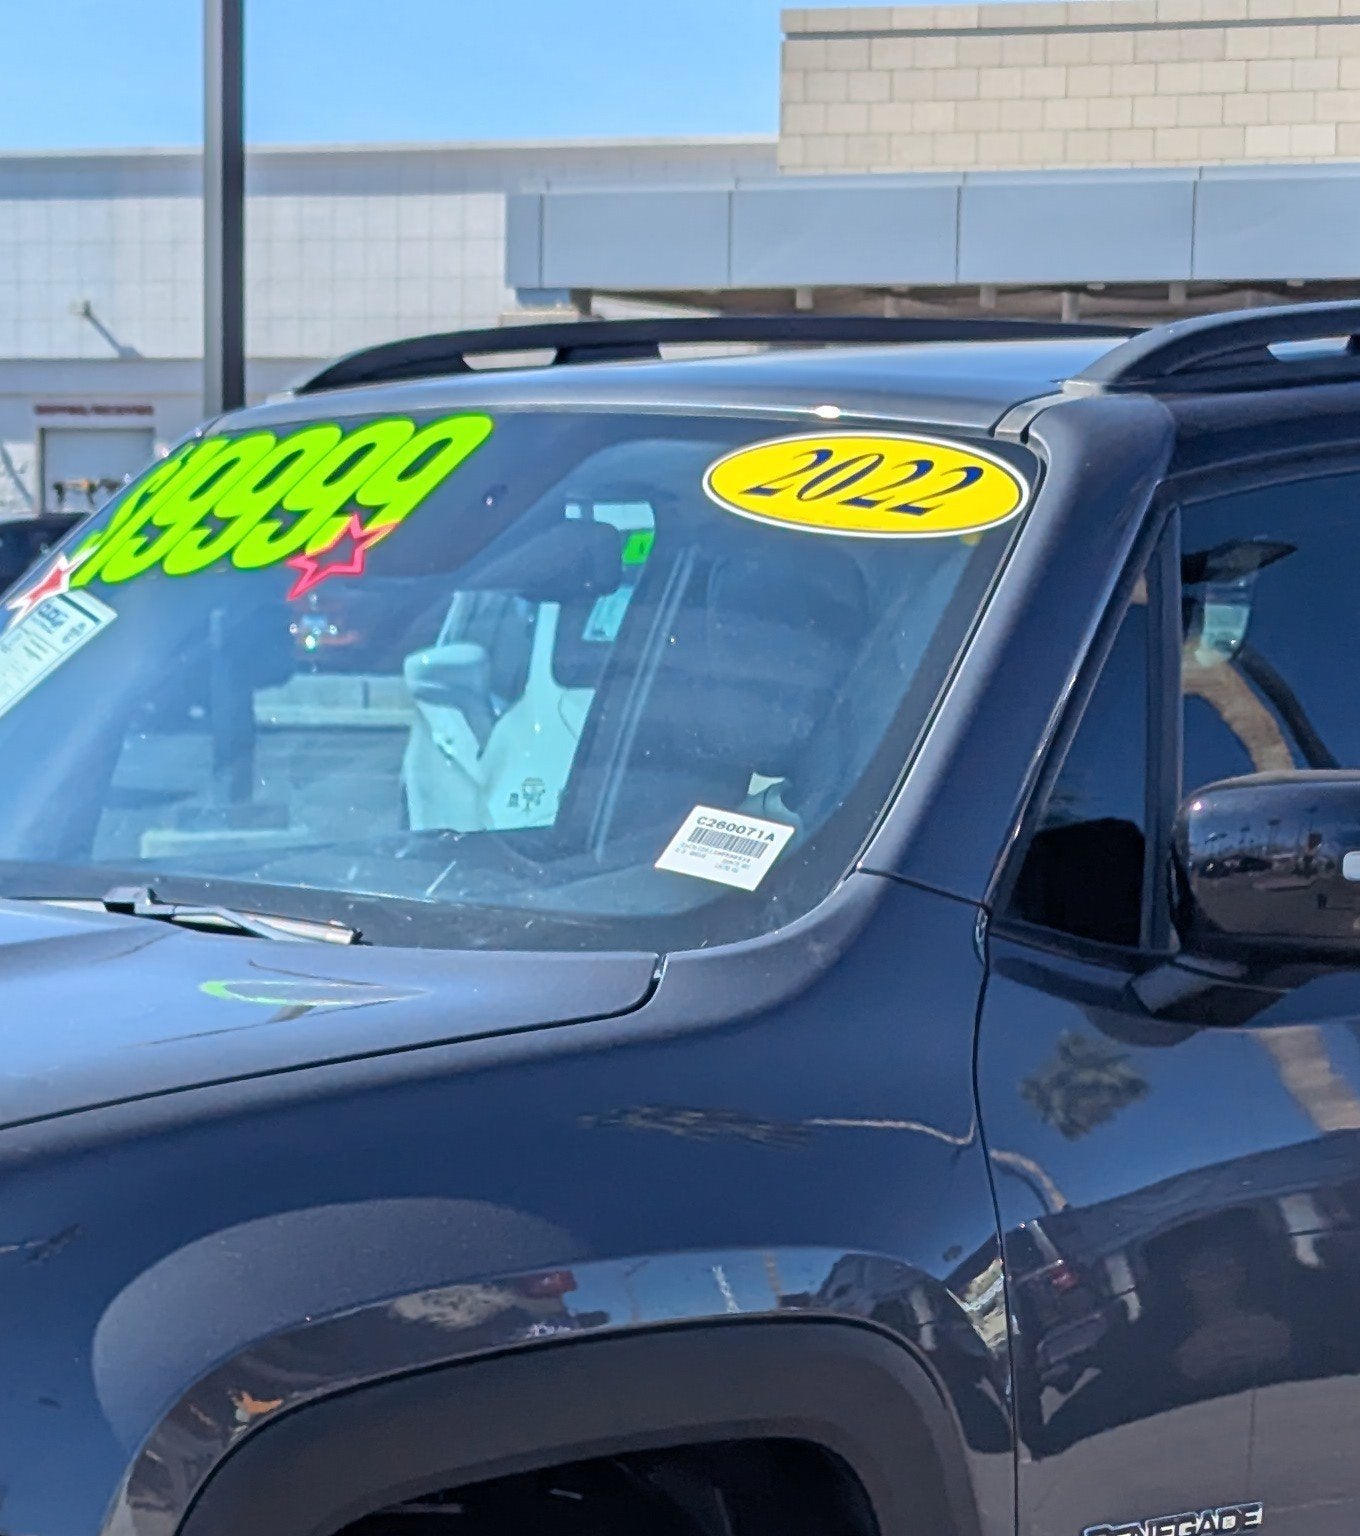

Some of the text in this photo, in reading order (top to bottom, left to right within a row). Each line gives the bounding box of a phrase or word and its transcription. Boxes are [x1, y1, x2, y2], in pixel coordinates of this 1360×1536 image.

[70, 412, 494, 587] $19999
[738, 448, 984, 517] 2022
[696, 816, 776, 842] C260071A
